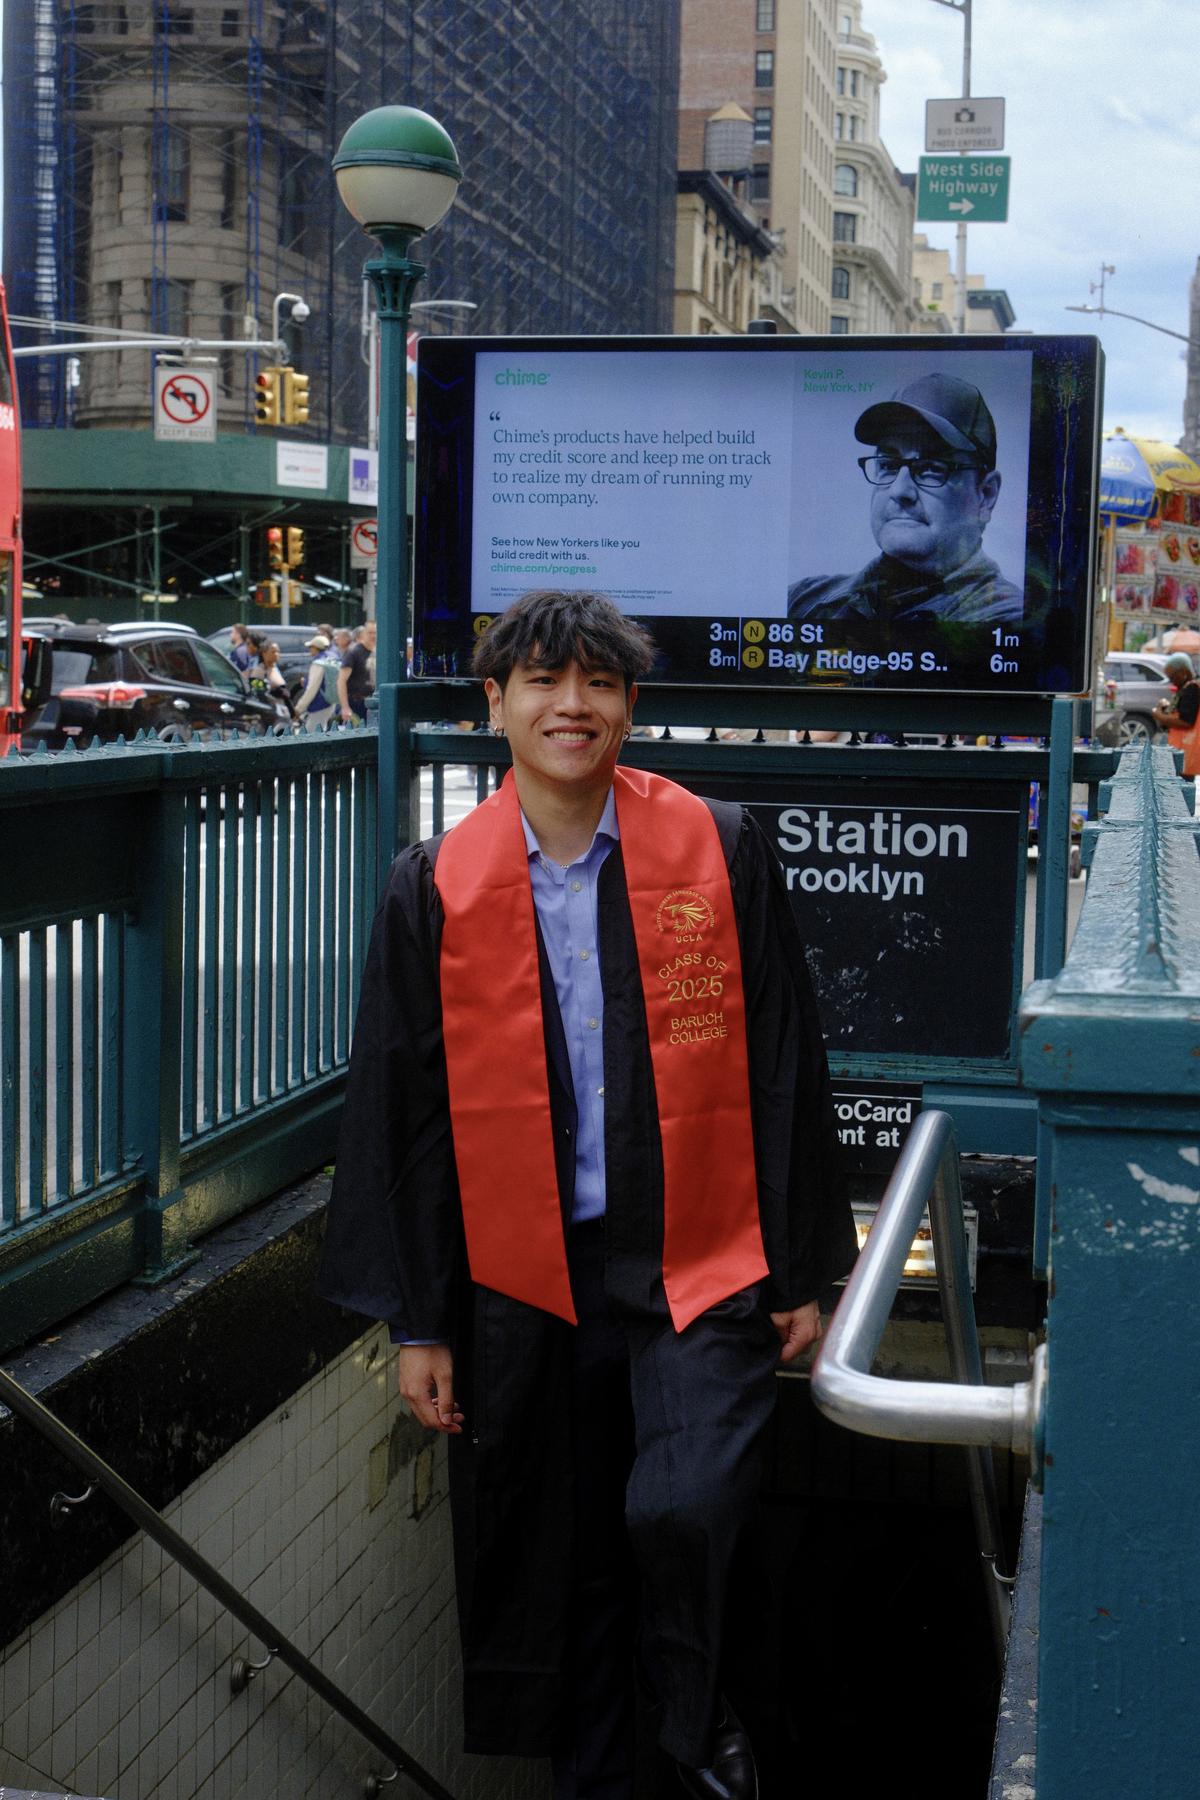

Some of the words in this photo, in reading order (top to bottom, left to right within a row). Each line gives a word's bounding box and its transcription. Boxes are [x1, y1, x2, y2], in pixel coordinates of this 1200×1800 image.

[925, 163, 964, 176] West
[970, 162, 1005, 176] Side
[929, 180, 999, 197] Highway
[494, 369, 548, 386] chime
[803, 369, 833, 379] Kevin
[803, 382, 828, 392] New
[830, 382, 856, 393] York,
[859, 382, 875, 392] NY
[553, 430, 620, 450] products
[624, 430, 659, 444] have
[663, 430, 712, 451] helped
[716, 430, 756, 444] build
[493, 453, 516, 466] my
[519, 450, 563, 464] credit
[567, 453, 606, 464] score
[610, 450, 639, 465] and
[643, 450, 678, 468] keep
[682, 454, 704, 465] me
[708, 454, 727, 465] on
[731, 451, 772, 466] track
[493, 470, 508, 484] to
[512, 470, 560, 484] realize
[564, 474, 587, 487] my
[591, 470, 640, 485] dream
[643, 469, 661, 485] of
[663, 472, 725, 488] running
[729, 475, 753, 489] my
[492, 492, 525, 504] own
[528, 492, 599, 508] company.
[491, 536, 511, 547] See
[512, 537, 534, 547] how
[536, 537, 558, 548] New
[560, 537, 599, 549] Yorkers
[601, 537, 619, 549] like
[621, 540, 640, 550] you
[491, 550, 517, 561] build
[519, 550, 549, 561] credit
[551, 550, 573, 561] with
[575, 552, 590, 561] us.
[490, 562, 598, 576] chime.com/progress
[709, 623, 737, 642] 3m
[749, 625, 759, 638] N
[768, 624, 794, 643] 86
[800, 624, 823, 643] St
[991, 628, 1019, 648] 1m
[709, 649, 736, 668] 8m
[748, 653, 758, 664] R
[768, 649, 809, 672] Bay
[816, 651, 913, 674] Ridge-95
[990, 654, 1018, 673] 6m
[777, 808, 968, 857] Station
[779, 861, 924, 900] rooklyn
[675, 933, 703, 944] UCLA
[658, 953, 702, 980] CLASS
[706, 955, 728, 972] OF
[667, 974, 724, 1003] 2025
[671, 1011, 723, 1031] BARUCH
[669, 1025, 728, 1045] COLLEGE
[875, 1127, 900, 1147] at
